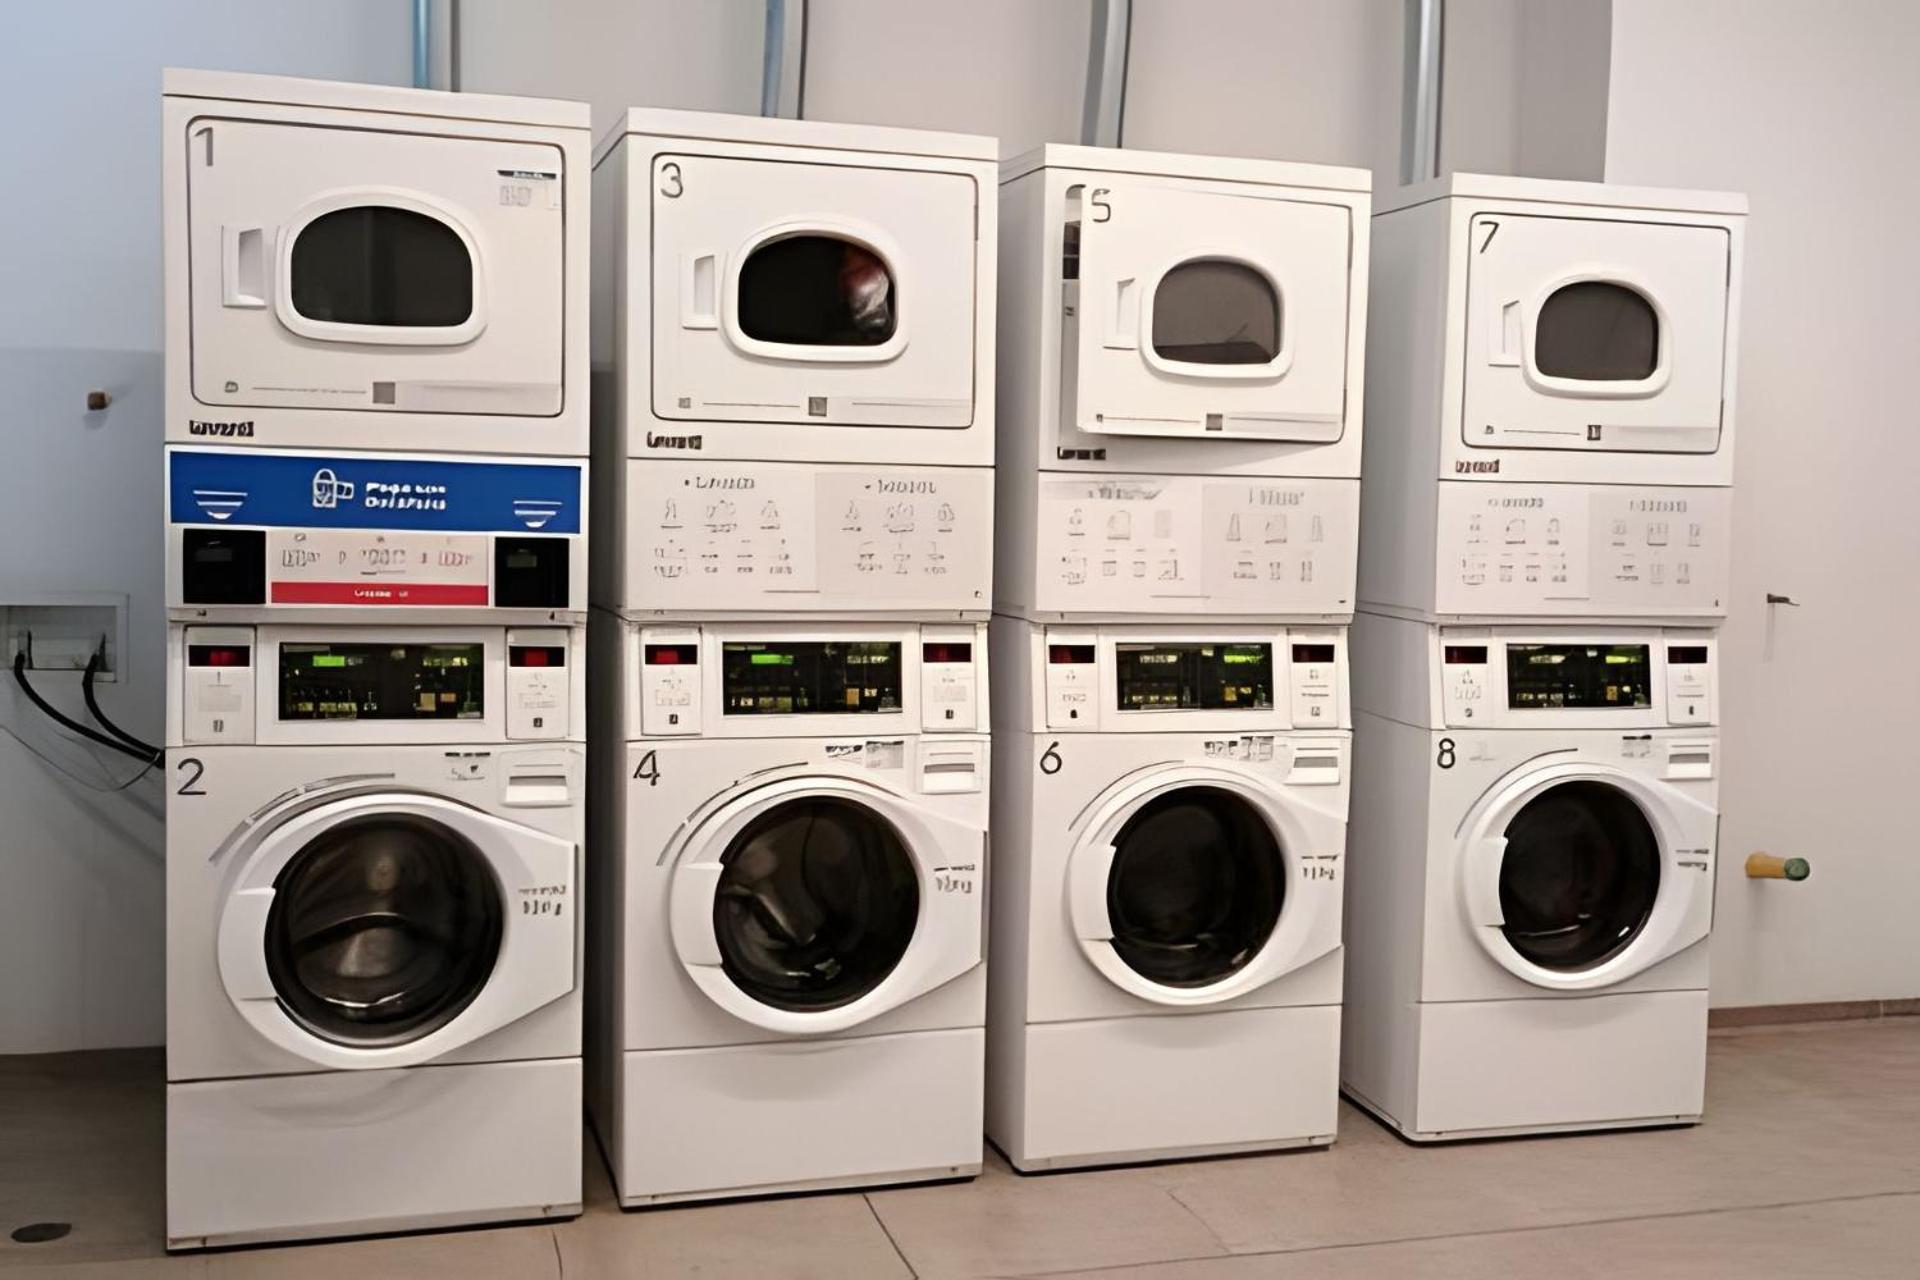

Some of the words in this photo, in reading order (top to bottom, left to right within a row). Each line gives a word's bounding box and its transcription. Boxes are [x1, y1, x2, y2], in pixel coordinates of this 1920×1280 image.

[195, 127, 213, 166] 1
[661, 163, 684, 198] 3
[1092, 188, 1111, 222] 5
[1479, 220, 1500, 254] 7
[633, 749, 661, 786] 4
[1040, 741, 1062, 774] 6
[1436, 738, 1457, 770] 8
[178, 759, 206, 794] 2
